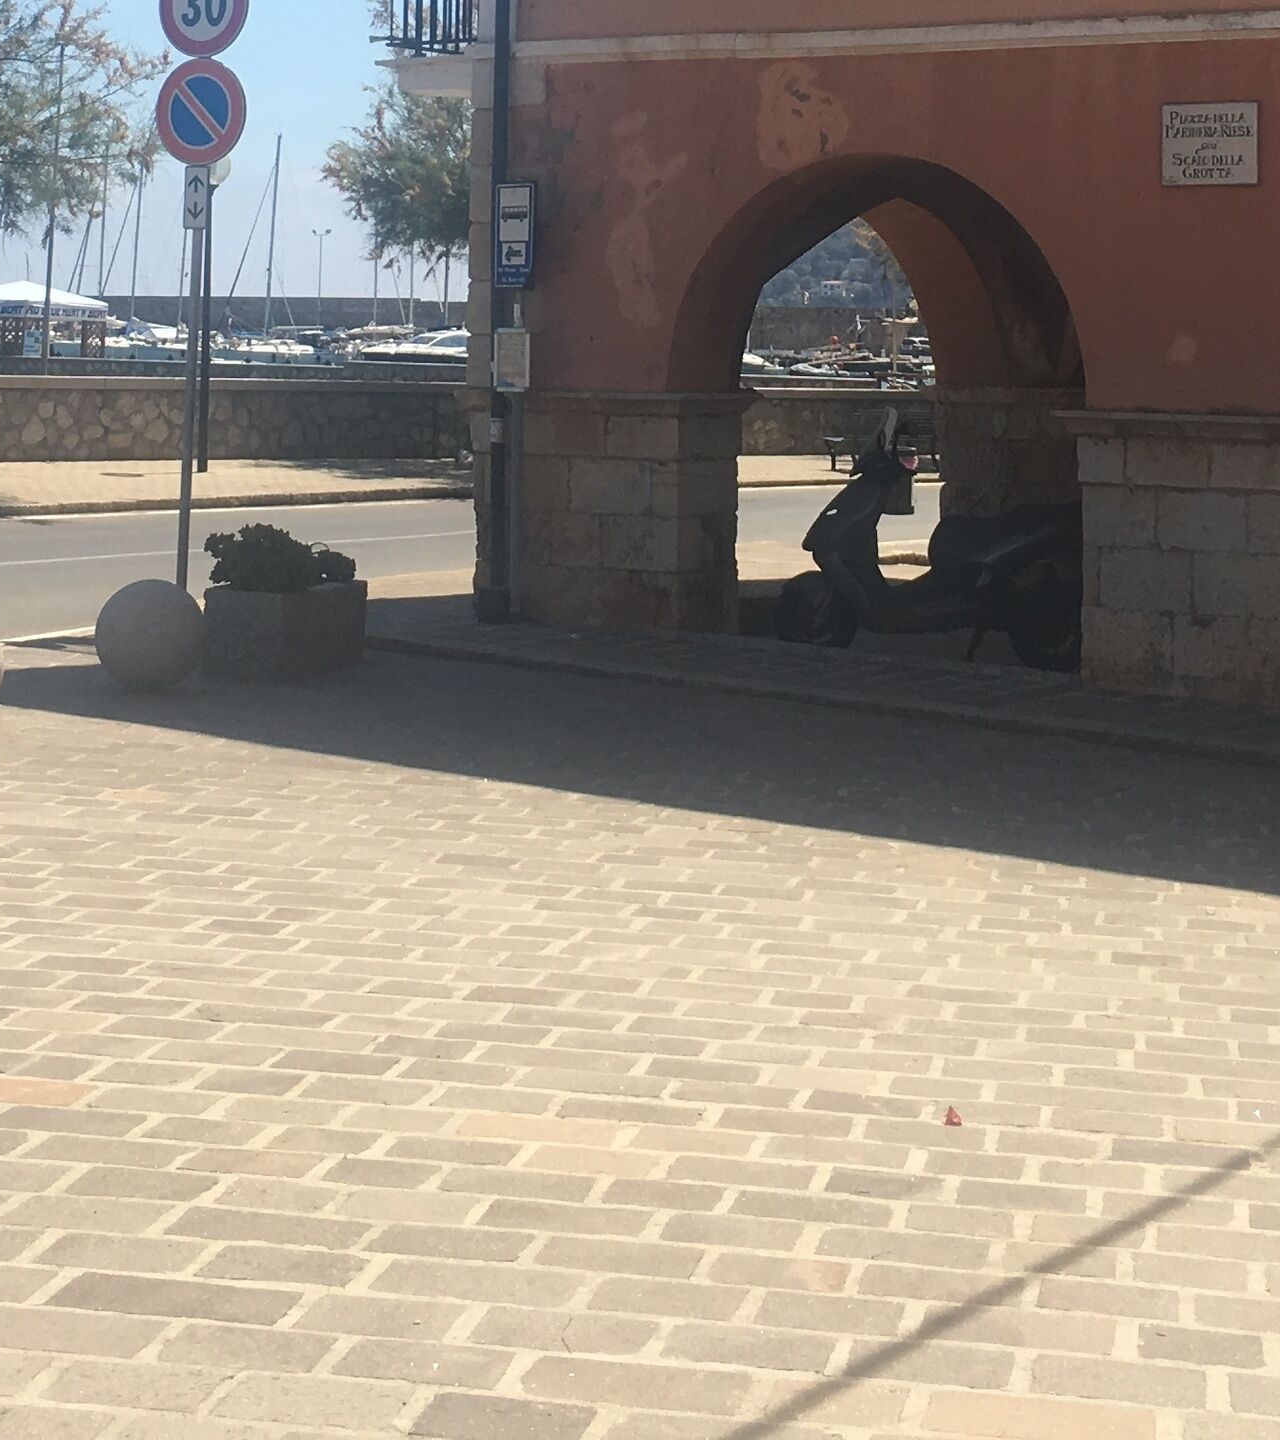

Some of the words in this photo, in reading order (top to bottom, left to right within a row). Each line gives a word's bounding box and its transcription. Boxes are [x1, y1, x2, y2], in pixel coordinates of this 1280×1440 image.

[1170, 111, 1211, 124] PIAZZA
[1213, 112, 1247, 123] DELLA
[1172, 152, 1208, 166] SCALO
[1211, 154, 1246, 166] DELLA
[1182, 167, 1234, 179] GROTTA
